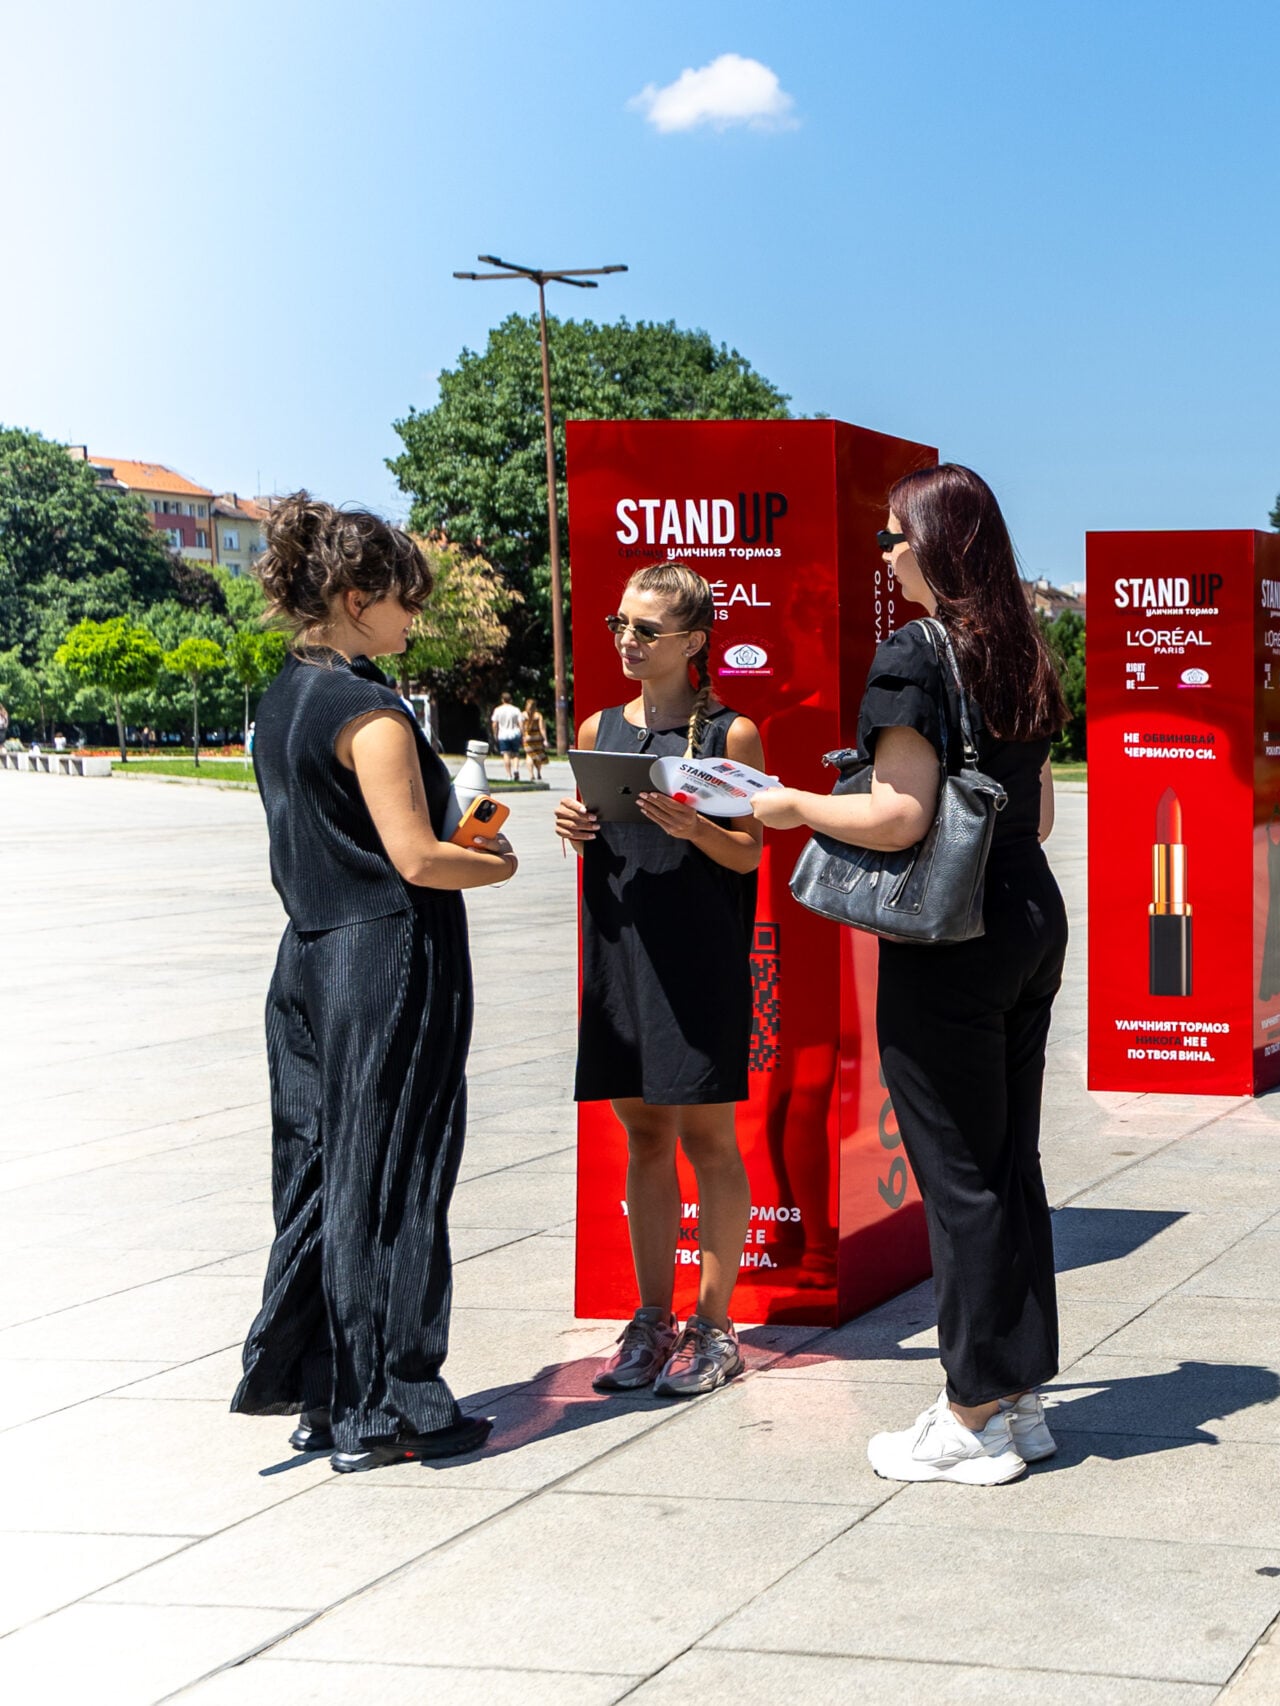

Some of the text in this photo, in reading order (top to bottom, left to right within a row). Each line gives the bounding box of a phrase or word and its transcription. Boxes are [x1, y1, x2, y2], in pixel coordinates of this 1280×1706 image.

[667, 548, 726, 560] уличния
[729, 547, 782, 560] тормоз
[1185, 607, 1219, 616] тормоз
[1127, 627, 1211, 647] L'ORÉAL
[1124, 733, 1139, 743] НЕ
[1124, 747, 1216, 759] ЧЕРВИЛОТО СИ.
[1115, 1020, 1230, 1033] УЛИЧНИЯТ ТОРМОЗ
[1135, 1035, 1180, 1046] НИКОГА
[1183, 1037, 1199, 1047] НЕ
[1127, 1049, 1215, 1062] ПО ТВОЯ ВИНА.
[750, 1206, 801, 1222] РМОЗ
